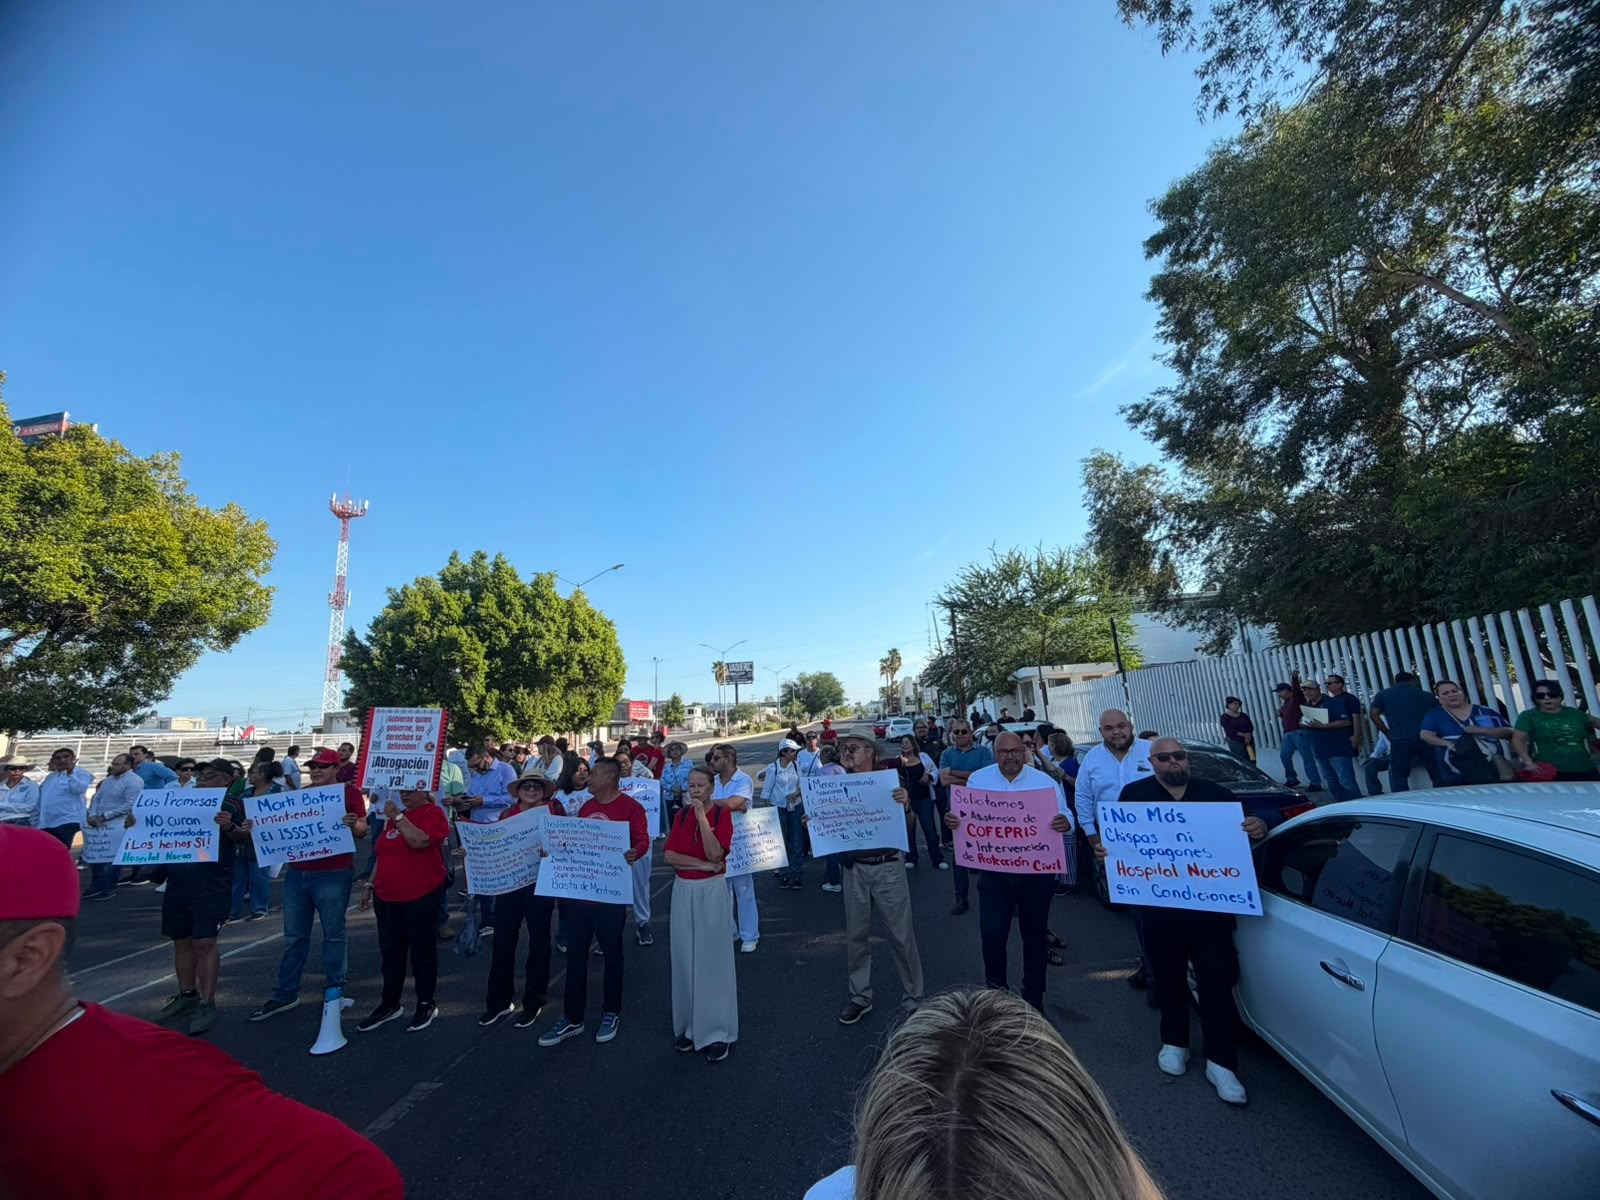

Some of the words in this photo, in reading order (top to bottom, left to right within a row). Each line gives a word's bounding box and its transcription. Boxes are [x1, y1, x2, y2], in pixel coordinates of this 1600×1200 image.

[415, 716, 432, 724] quien
[372, 756, 429, 770] ¡Abrogación
[389, 775, 405, 787] ya!
[136, 794, 160, 807] Las
[164, 791, 218, 807] Promesas
[302, 792, 341, 806] Batres
[955, 789, 1025, 810] Solicitamos
[145, 814, 163, 827] NO
[971, 810, 1016, 823] Asistencia
[1023, 813, 1036, 823] de
[1102, 807, 1137, 823] ¡No
[1146, 807, 1186, 823] Más
[260, 831, 274, 842] El
[278, 822, 326, 840] ISSSTE
[967, 823, 1037, 838] COFEPRIS
[159, 840, 191, 848] hechos
[1104, 828, 1158, 849] Chispas
[1176, 831, 1195, 843] ni
[260, 841, 314, 856] Hermosillo
[976, 840, 1050, 853] Intervención
[122, 852, 160, 862] Hospital
[962, 851, 974, 862] de
[977, 853, 1029, 867] Protección
[1033, 858, 1061, 872] Civil
[1139, 847, 1213, 862] apagones
[1116, 859, 1179, 881] Hospital
[1187, 862, 1241, 878] Nuevo
[1151, 883, 1256, 910] Condiciones!
